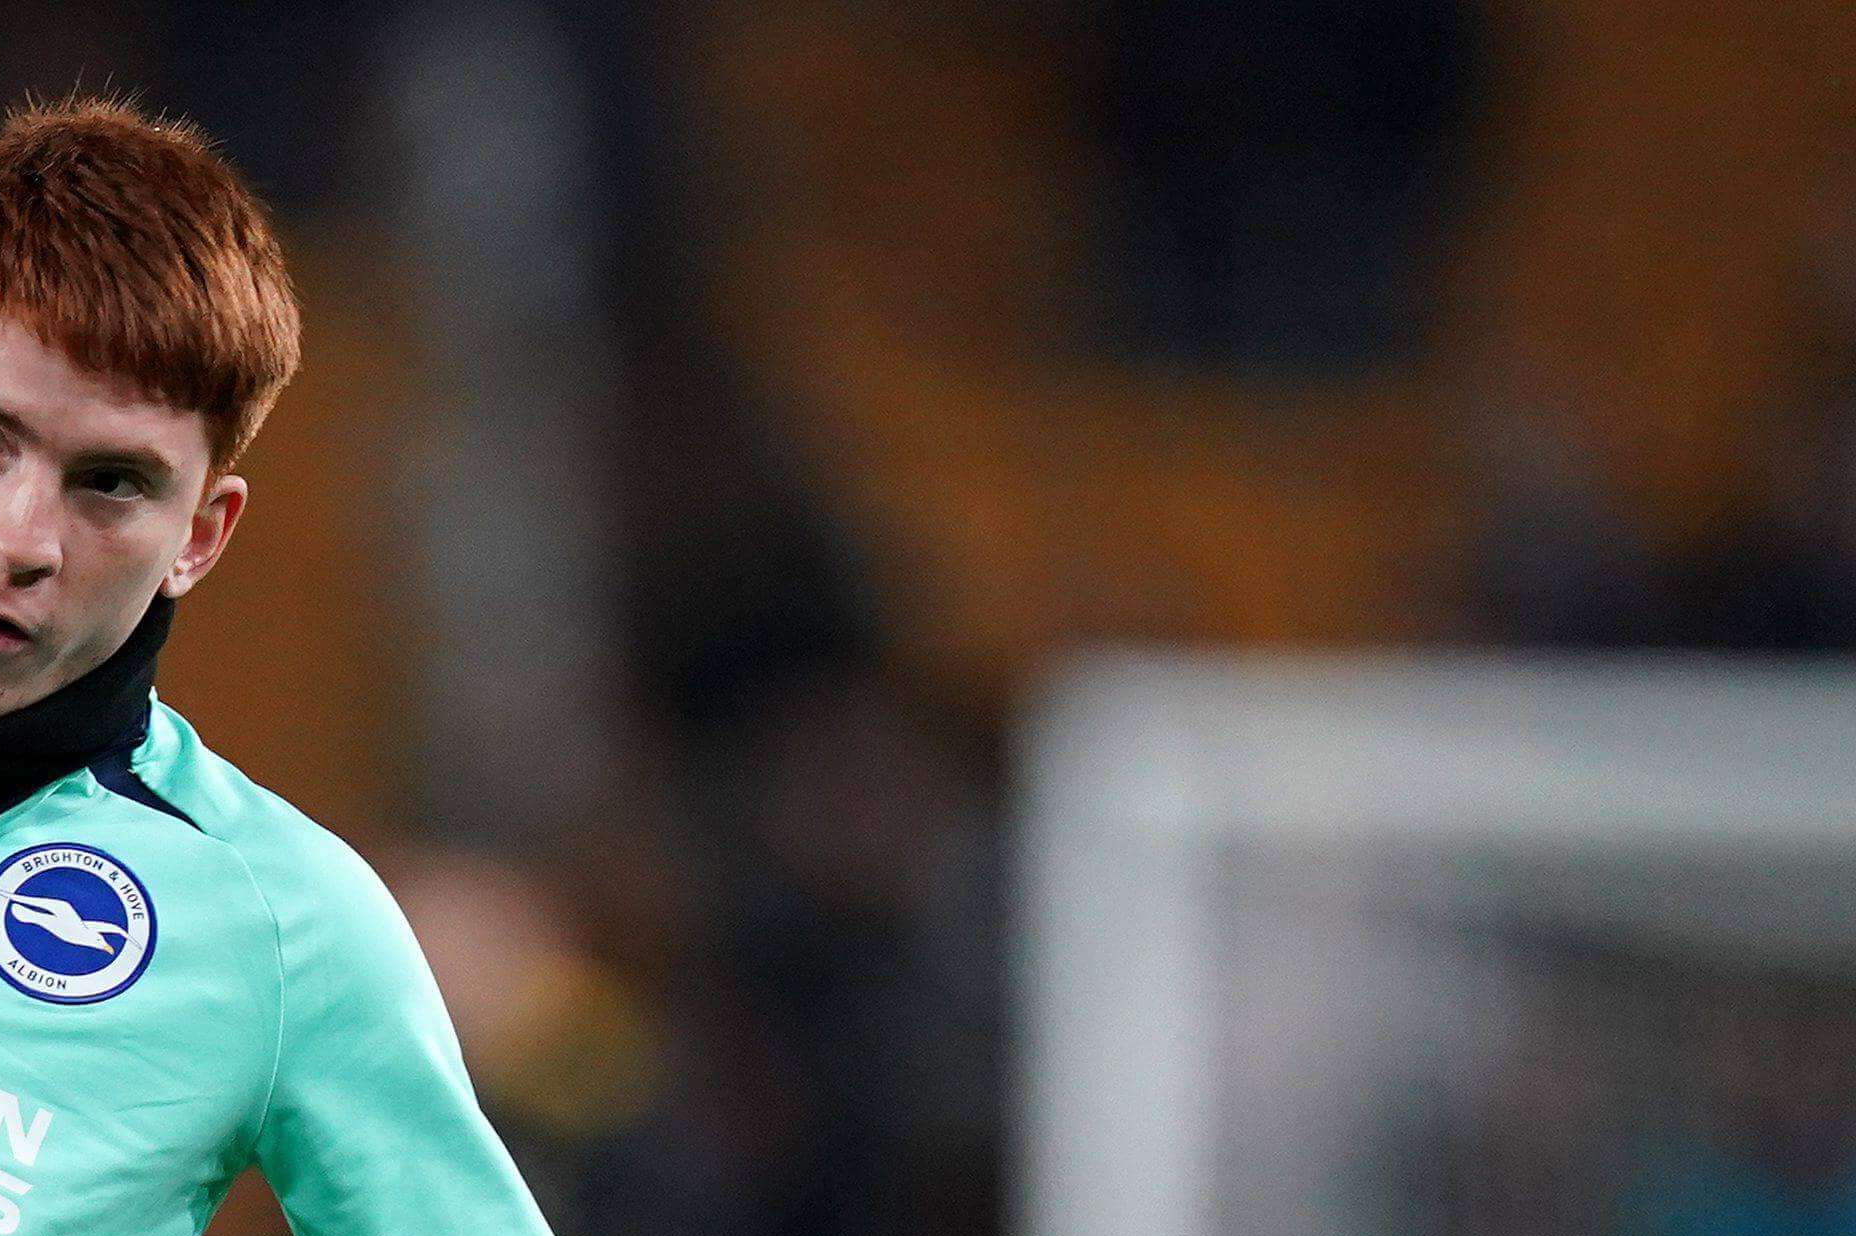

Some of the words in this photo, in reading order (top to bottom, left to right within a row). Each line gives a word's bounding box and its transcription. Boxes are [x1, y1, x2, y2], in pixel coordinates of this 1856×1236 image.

[22, 852, 104, 873] BRIGHTON
[108, 870, 119, 882] &
[120, 883, 145, 920] HOVE
[7, 959, 68, 990] ALBION
